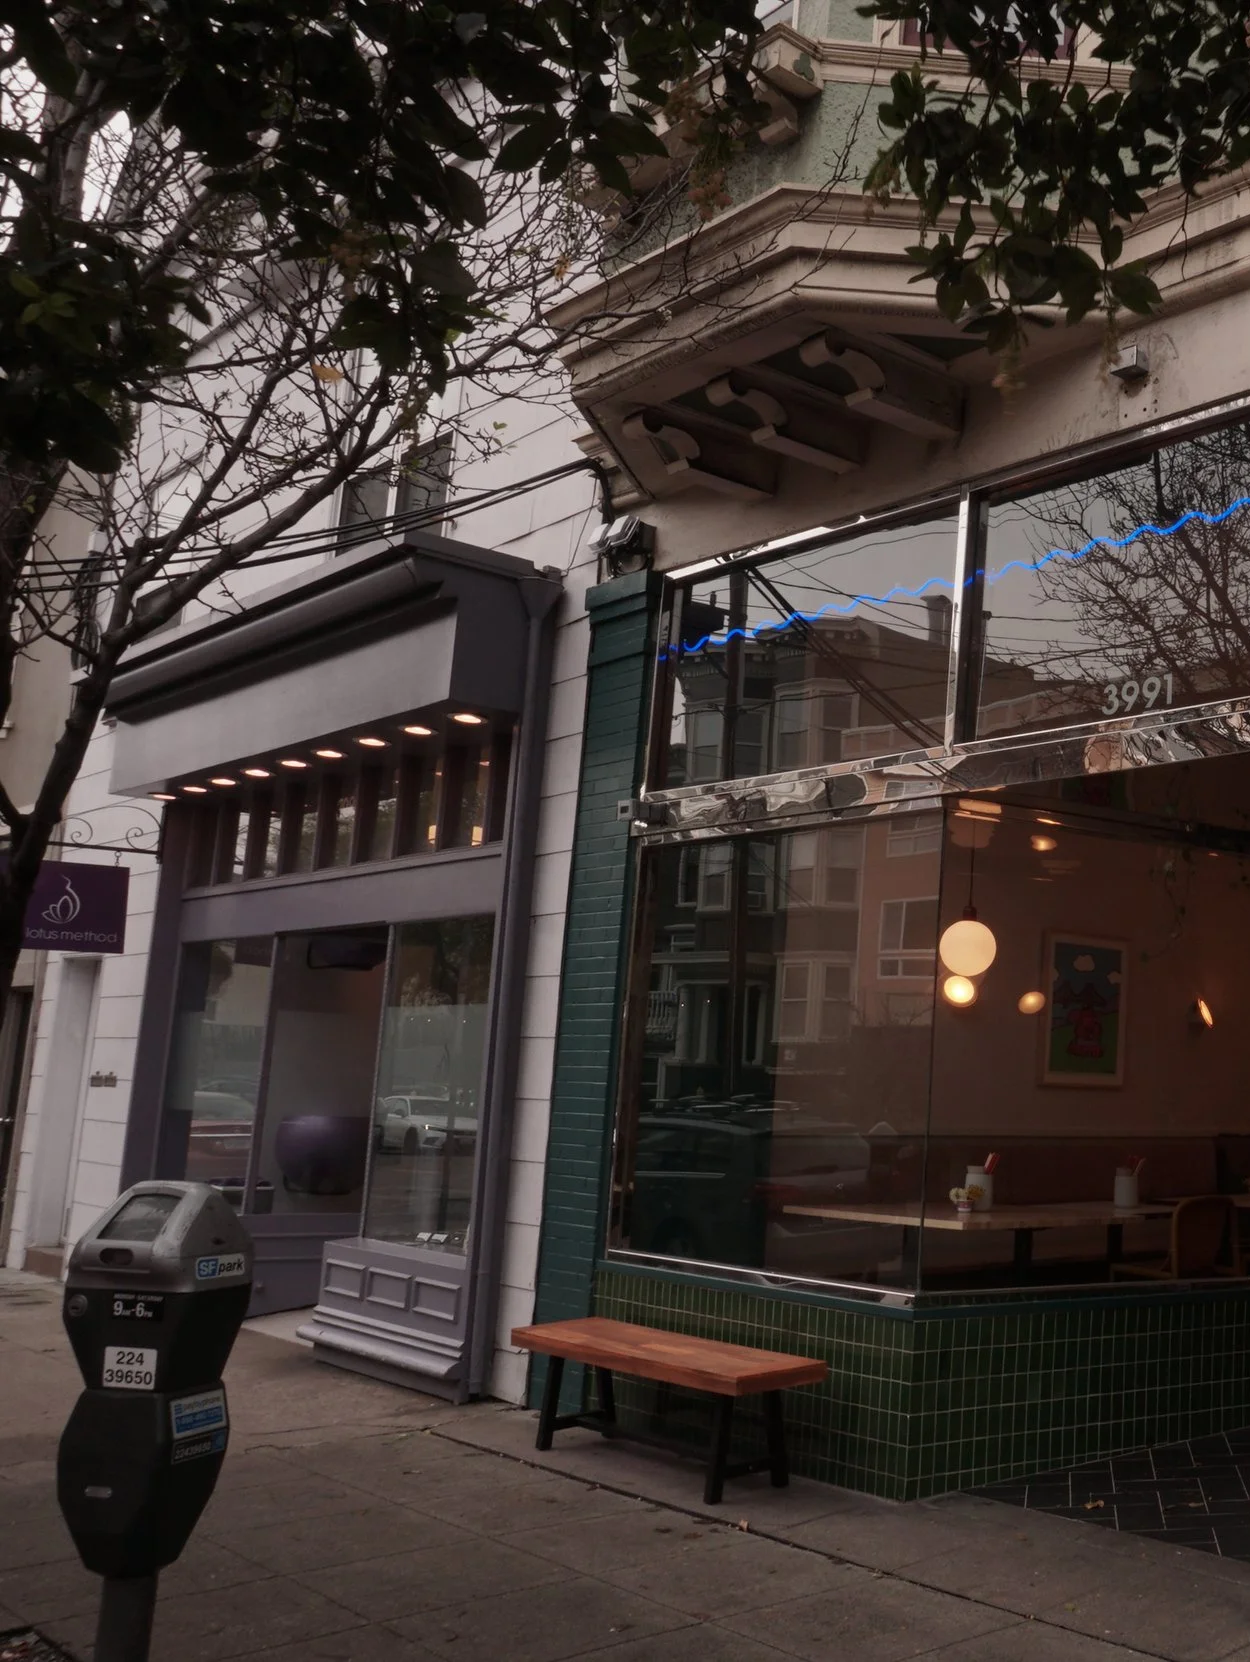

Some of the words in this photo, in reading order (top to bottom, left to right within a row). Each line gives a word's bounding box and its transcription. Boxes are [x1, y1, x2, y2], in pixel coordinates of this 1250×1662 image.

[1101, 672, 1173, 716] 3991
[25, 927, 59, 940] lotus
[60, 930, 118, 943] method
[116, 1351, 145, 1366] 224
[104, 1369, 153, 1385] 39650
